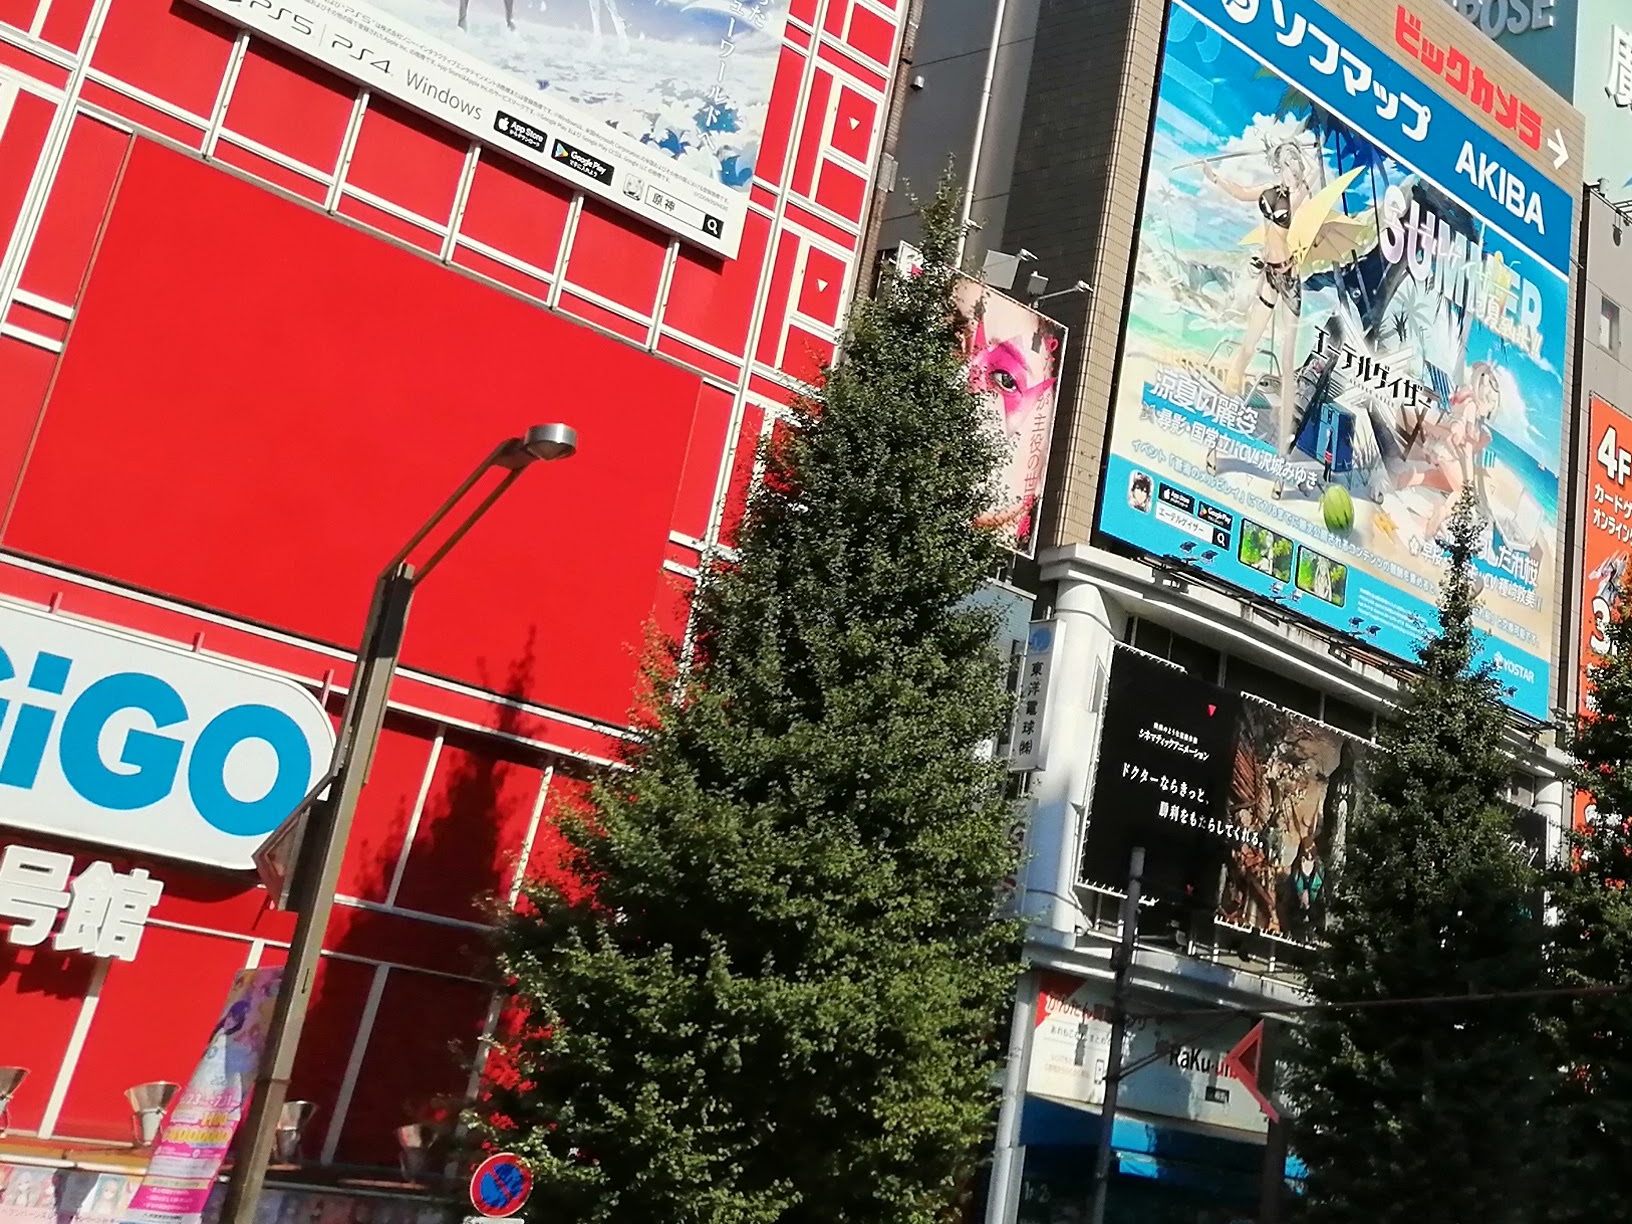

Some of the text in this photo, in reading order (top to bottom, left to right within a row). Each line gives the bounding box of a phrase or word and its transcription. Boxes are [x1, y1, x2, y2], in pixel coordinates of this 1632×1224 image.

[407, 67, 483, 121] Windows
[1394, 3, 1543, 152] ビックカメラ
[569, 148, 607, 177] Google Play
[1455, 140, 1546, 235] AKIBA
[651, 191, 676, 214] 原神
[1312, 325, 1434, 411] エーテルゲイザー
[1597, 424, 1632, 486] 4F
[1503, 659, 1536, 685] YOSTAR
[0, 644, 312, 838] iGO
[1121, 762, 1210, 806] ドクターならきっと、
